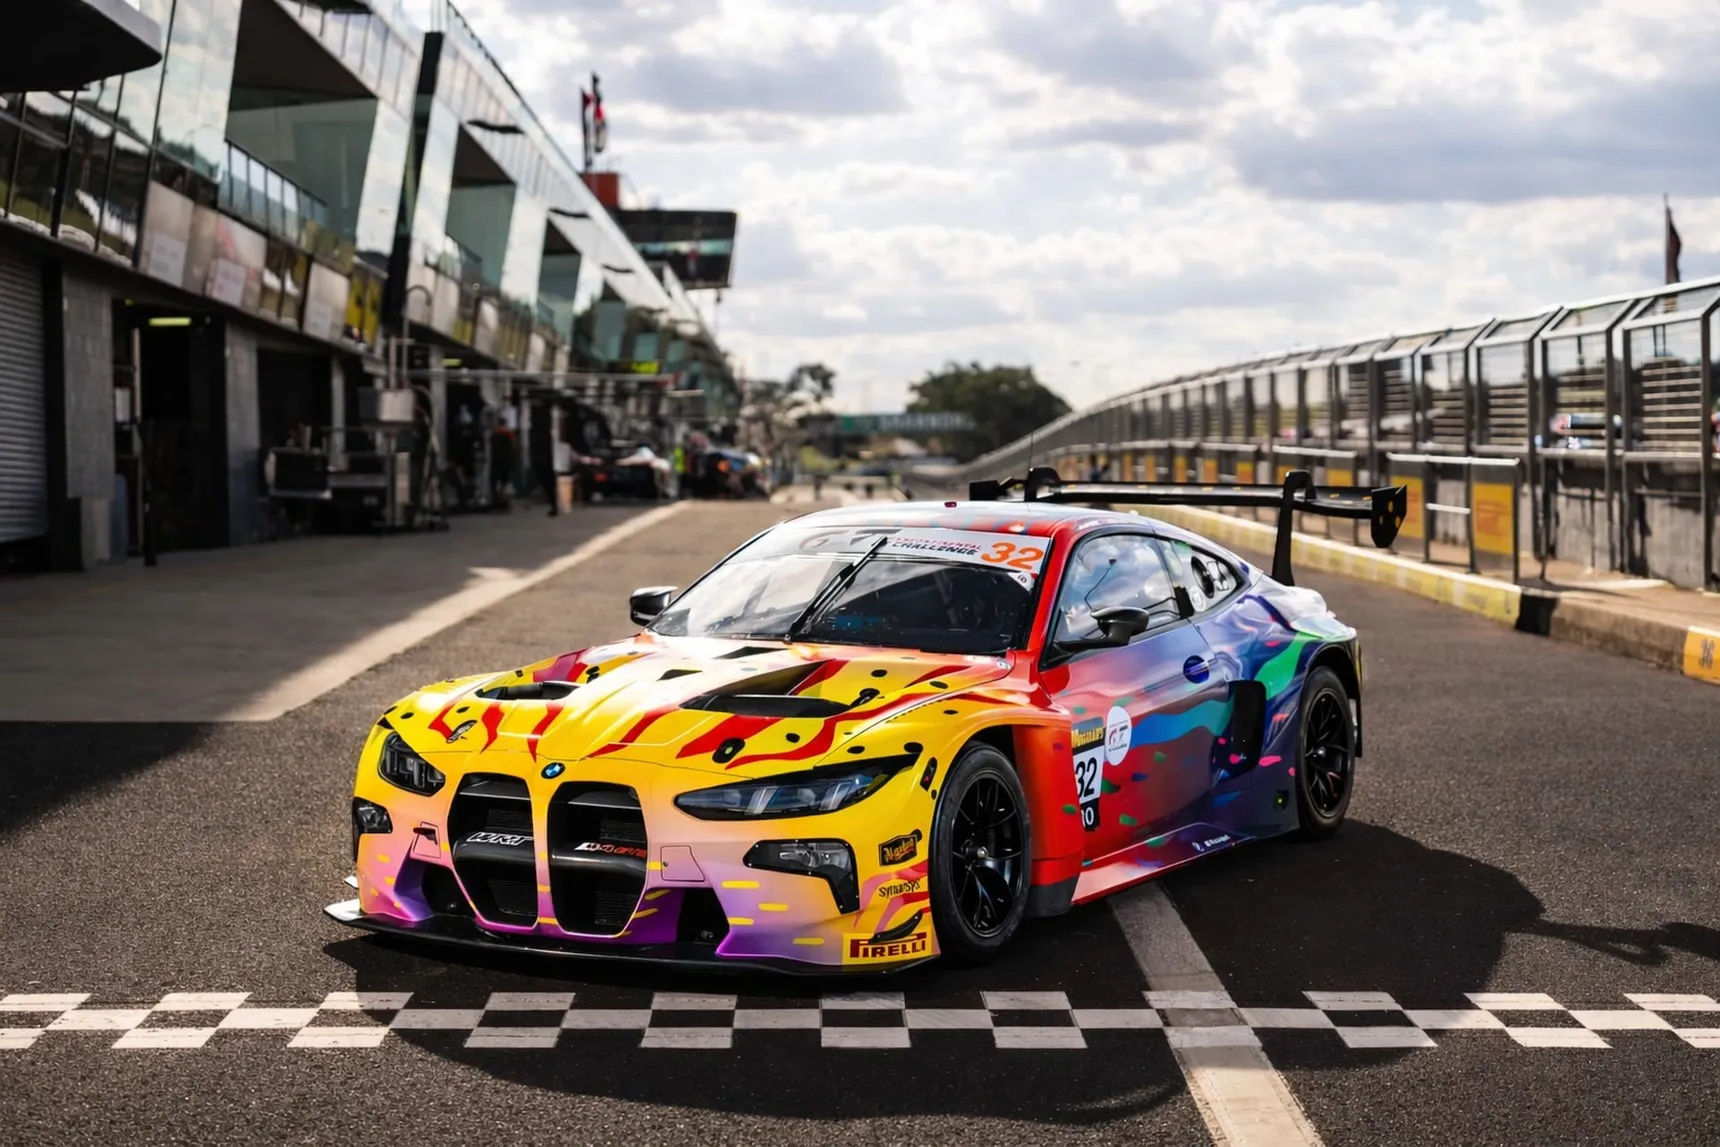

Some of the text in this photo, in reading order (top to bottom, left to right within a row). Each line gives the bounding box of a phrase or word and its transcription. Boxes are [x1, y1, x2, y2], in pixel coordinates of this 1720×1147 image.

[981, 542, 1044, 570] 32
[1075, 757, 1097, 798] 32
[850, 932, 927, 958] PIRELLI
